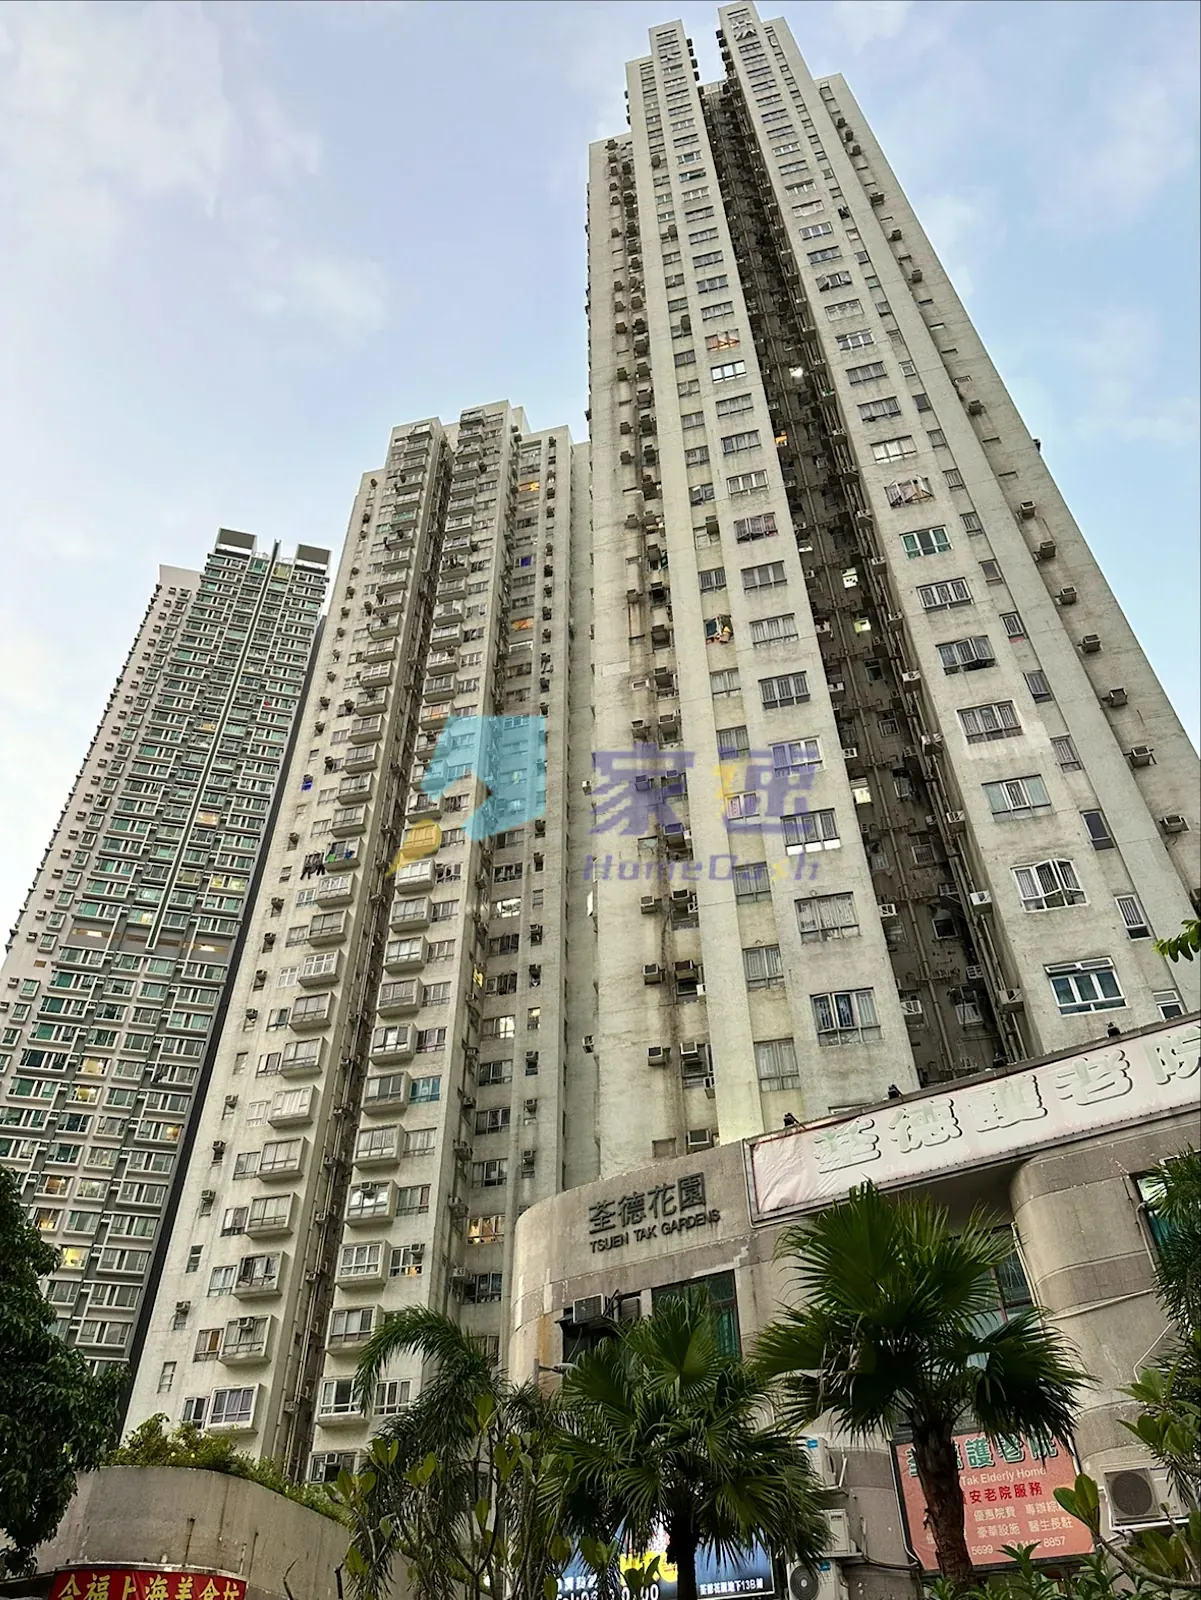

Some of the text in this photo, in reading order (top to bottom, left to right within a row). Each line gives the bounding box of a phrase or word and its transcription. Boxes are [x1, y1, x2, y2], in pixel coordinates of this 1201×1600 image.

[588, 1172, 707, 1235] 荃德花園
[590, 1209, 721, 1254] TSUEN TAK GARDENS
[960, 1466, 1047, 1487] Tak Elderly Home
[962, 1482, 1043, 1506] 安老院服務
[971, 1544, 994, 1556] 5699
[1043, 1536, 1066, 1548] 8857
